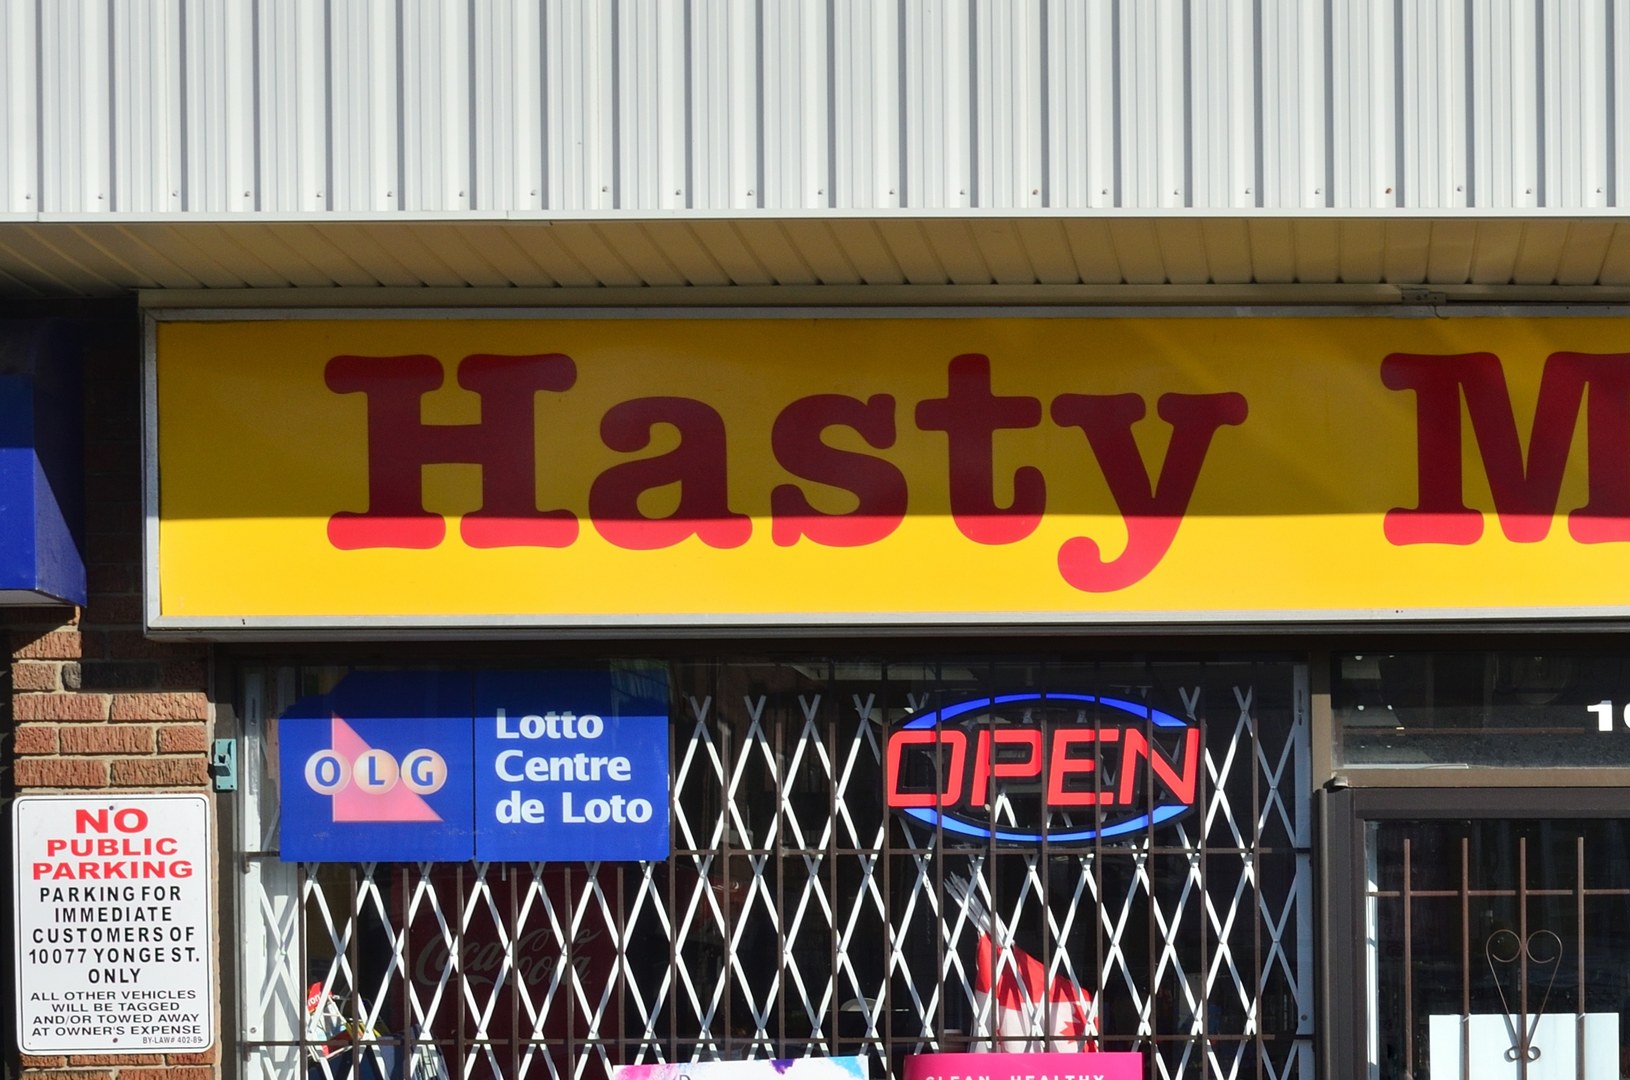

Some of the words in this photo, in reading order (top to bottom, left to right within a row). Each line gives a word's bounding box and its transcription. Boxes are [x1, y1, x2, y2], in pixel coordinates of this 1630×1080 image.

[324, 353, 1248, 594] Hasty
[496, 708, 604, 740] Lotto
[313, 755, 435, 788] OLG
[495, 749, 631, 783] Centre
[887, 728, 1200, 808] OPEN
[495, 790, 545, 824] de
[562, 791, 653, 824] Loto
[75, 808, 149, 834] NO
[47, 837, 178, 857] PUBLIC
[32, 860, 193, 881] PARKING
[40, 886, 135, 902] PARKING
[141, 885, 182, 901] FOR
[54, 906, 172, 923] IMMEDIATE
[32, 927, 164, 943] CUSTOMERS
[169, 926, 195, 942] OF
[29, 948, 87, 964] 10077
[93, 947, 165, 963] YONGE
[171, 947, 200, 962] ST.
[88, 968, 141, 984] ONLY
[30, 991, 60, 1001] ALL
[64, 990, 116, 1001] OTHER
[121, 989, 196, 1000] VEHICLES
[51, 1002, 89, 1013] WILL
[94, 1002, 113, 1012] BE
[118, 1001, 180, 1012] TAGGED
[32, 1014, 92, 1025] AND/OR
[97, 1013, 153, 1024] TOWED
[158, 1013, 200, 1023] AWAY
[32, 1026, 51, 1036] AT
[55, 1025, 125, 1036] OWNER'S
[130, 1024, 201, 1035] EXPENSE
